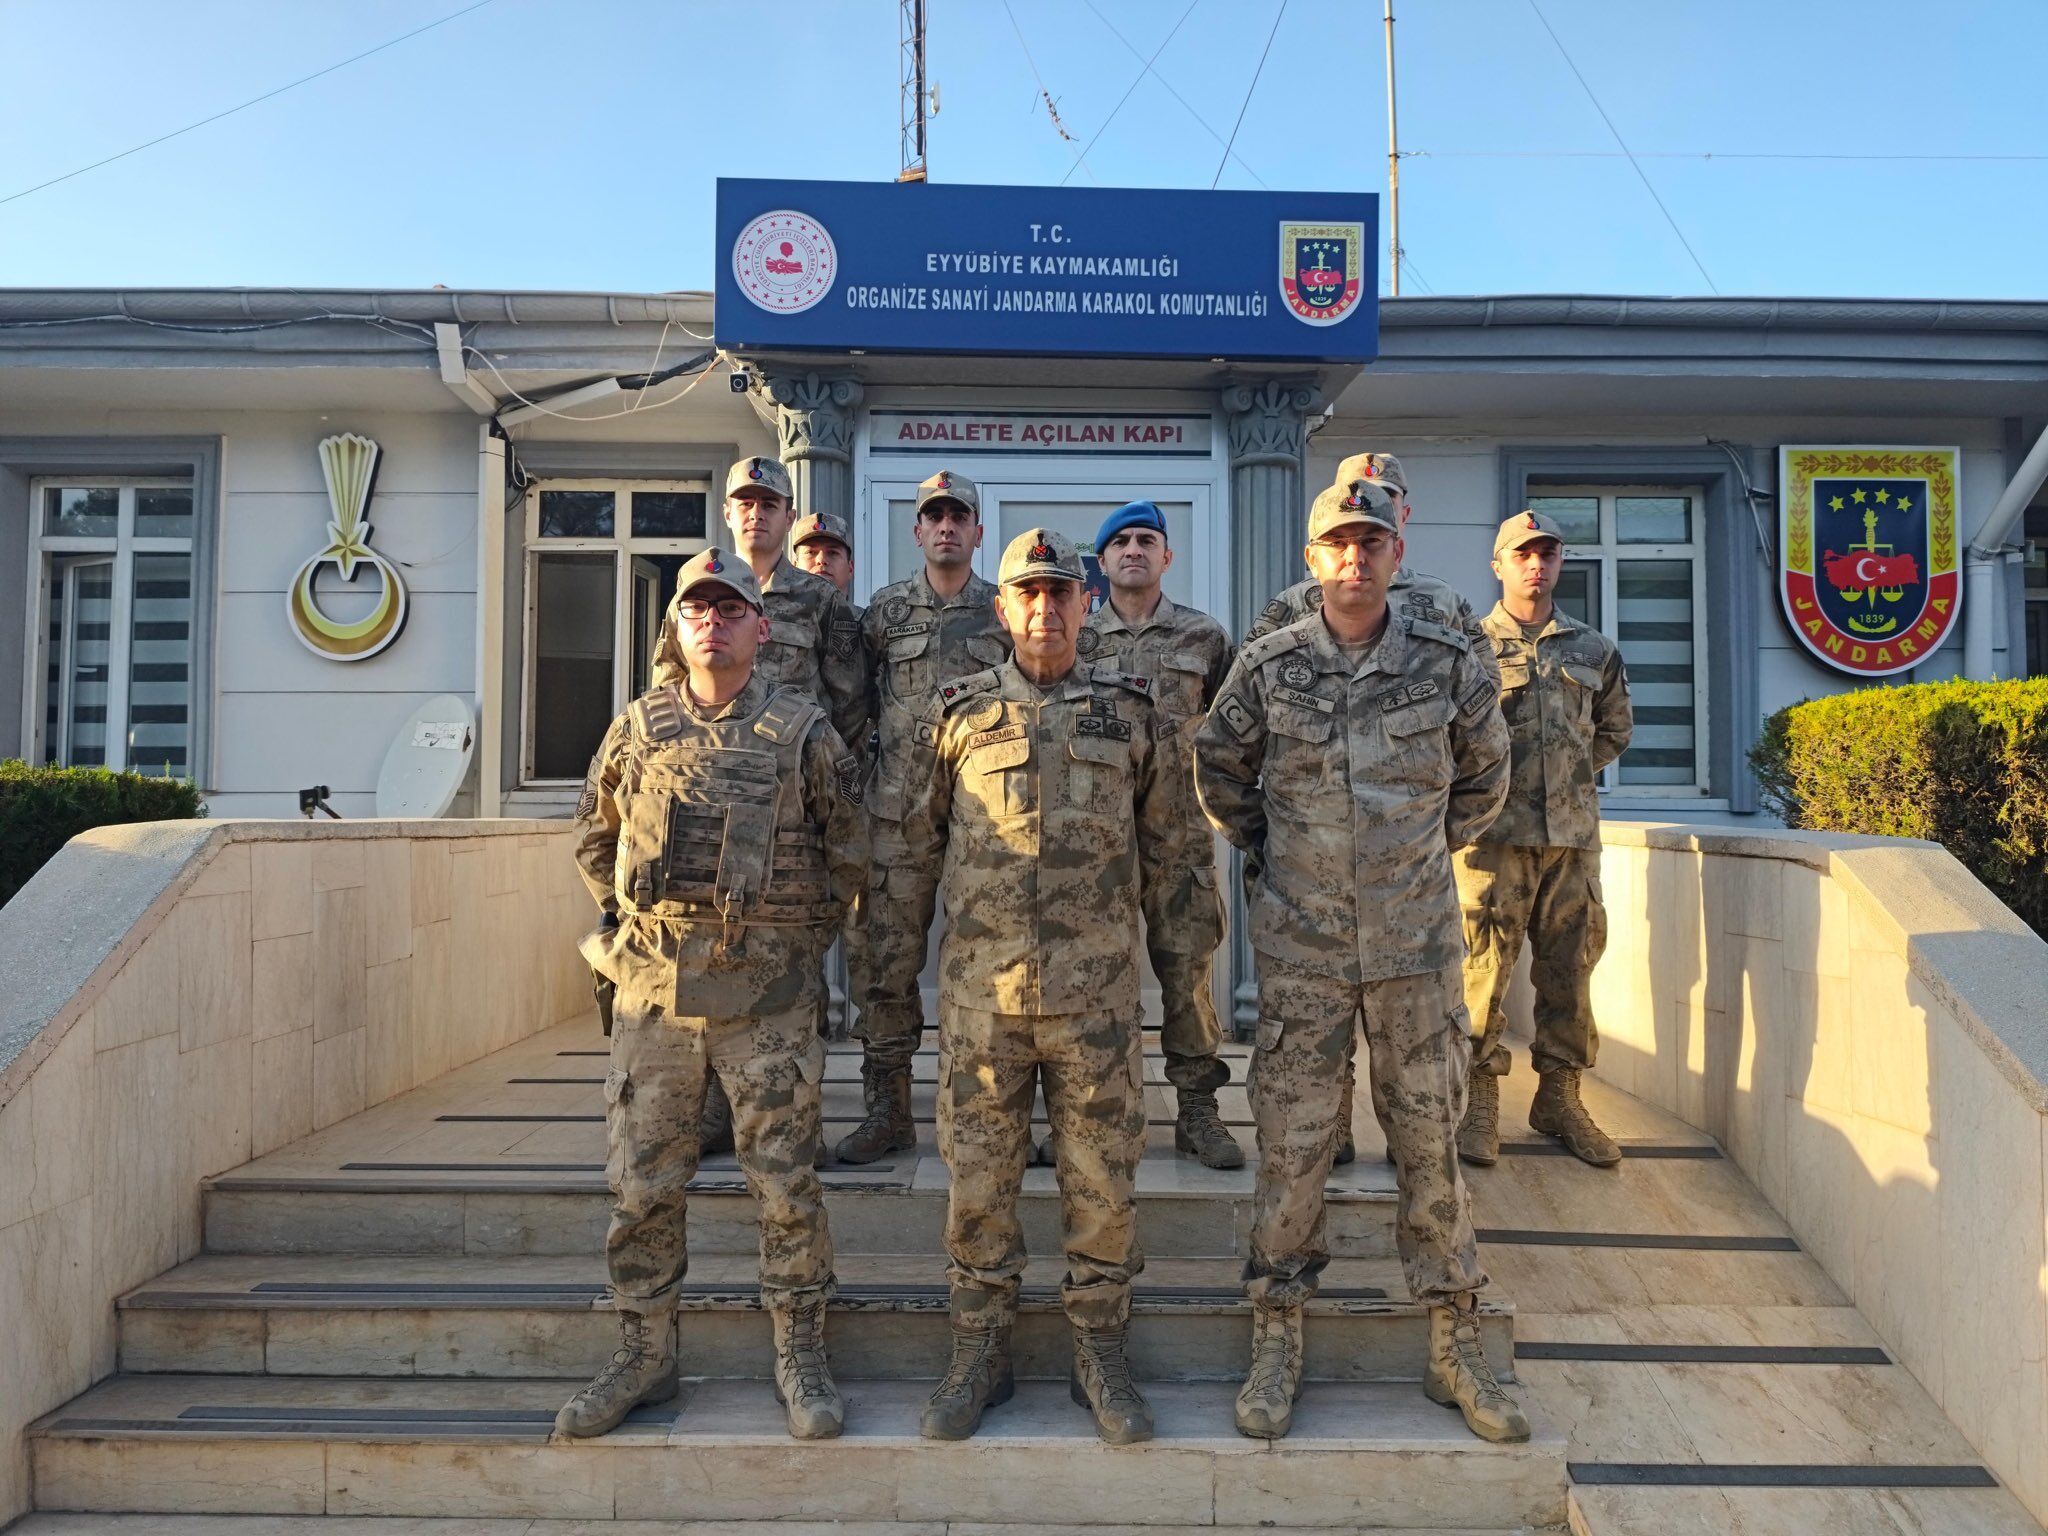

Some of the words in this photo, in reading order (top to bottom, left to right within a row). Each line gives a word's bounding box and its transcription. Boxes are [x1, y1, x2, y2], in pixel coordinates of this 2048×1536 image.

[1029, 224, 1072, 243] T.C.
[926, 251, 1024, 274] EYYÜBİYE
[1029, 254, 1179, 277] KAYMAKAMLIĞI
[846, 282, 927, 310] ORGANİZE
[931, 284, 988, 311] SANAYİ
[992, 290, 1078, 313] JANDARMA
[1082, 291, 1155, 315] KARAKOL
[1160, 290, 1268, 317] KOMUTANLIĞI
[1286, 288, 1356, 319] JANDARMA
[897, 421, 1014, 442] ADALETE
[1020, 423, 1115, 447] AÇILAN
[1123, 424, 1183, 443] KAPI
[1794, 596, 1951, 665] JANDARMA
[1859, 613, 1885, 624] 1839
